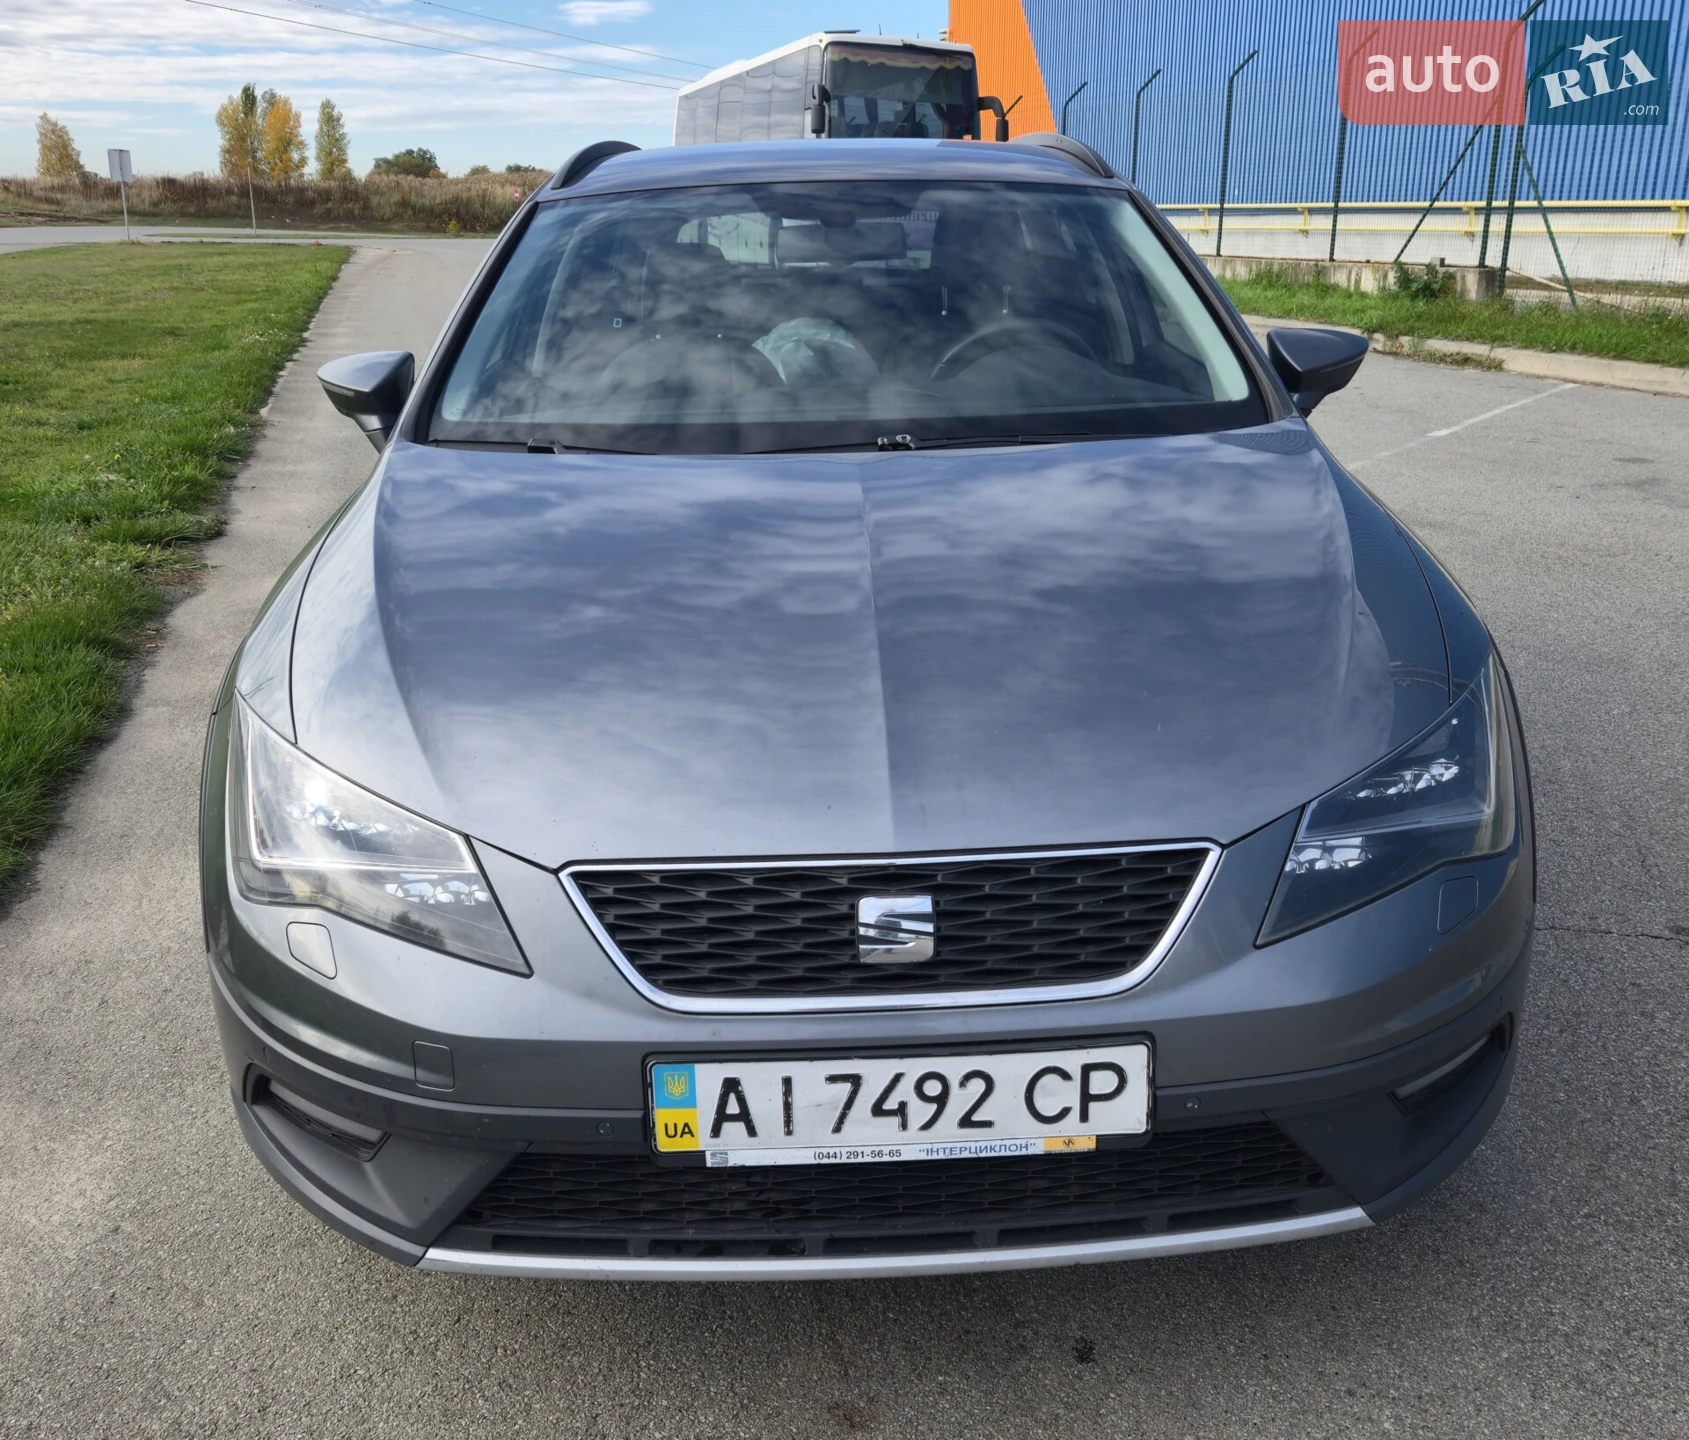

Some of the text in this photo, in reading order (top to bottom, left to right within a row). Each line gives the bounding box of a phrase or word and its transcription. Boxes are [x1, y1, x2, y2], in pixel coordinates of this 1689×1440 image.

[824, 1069, 996, 1134] 7492
[1024, 1061, 1128, 1125] CP
[664, 1122, 695, 1138] UA
[813, 1149, 902, 1161] (044) 291-56-65
